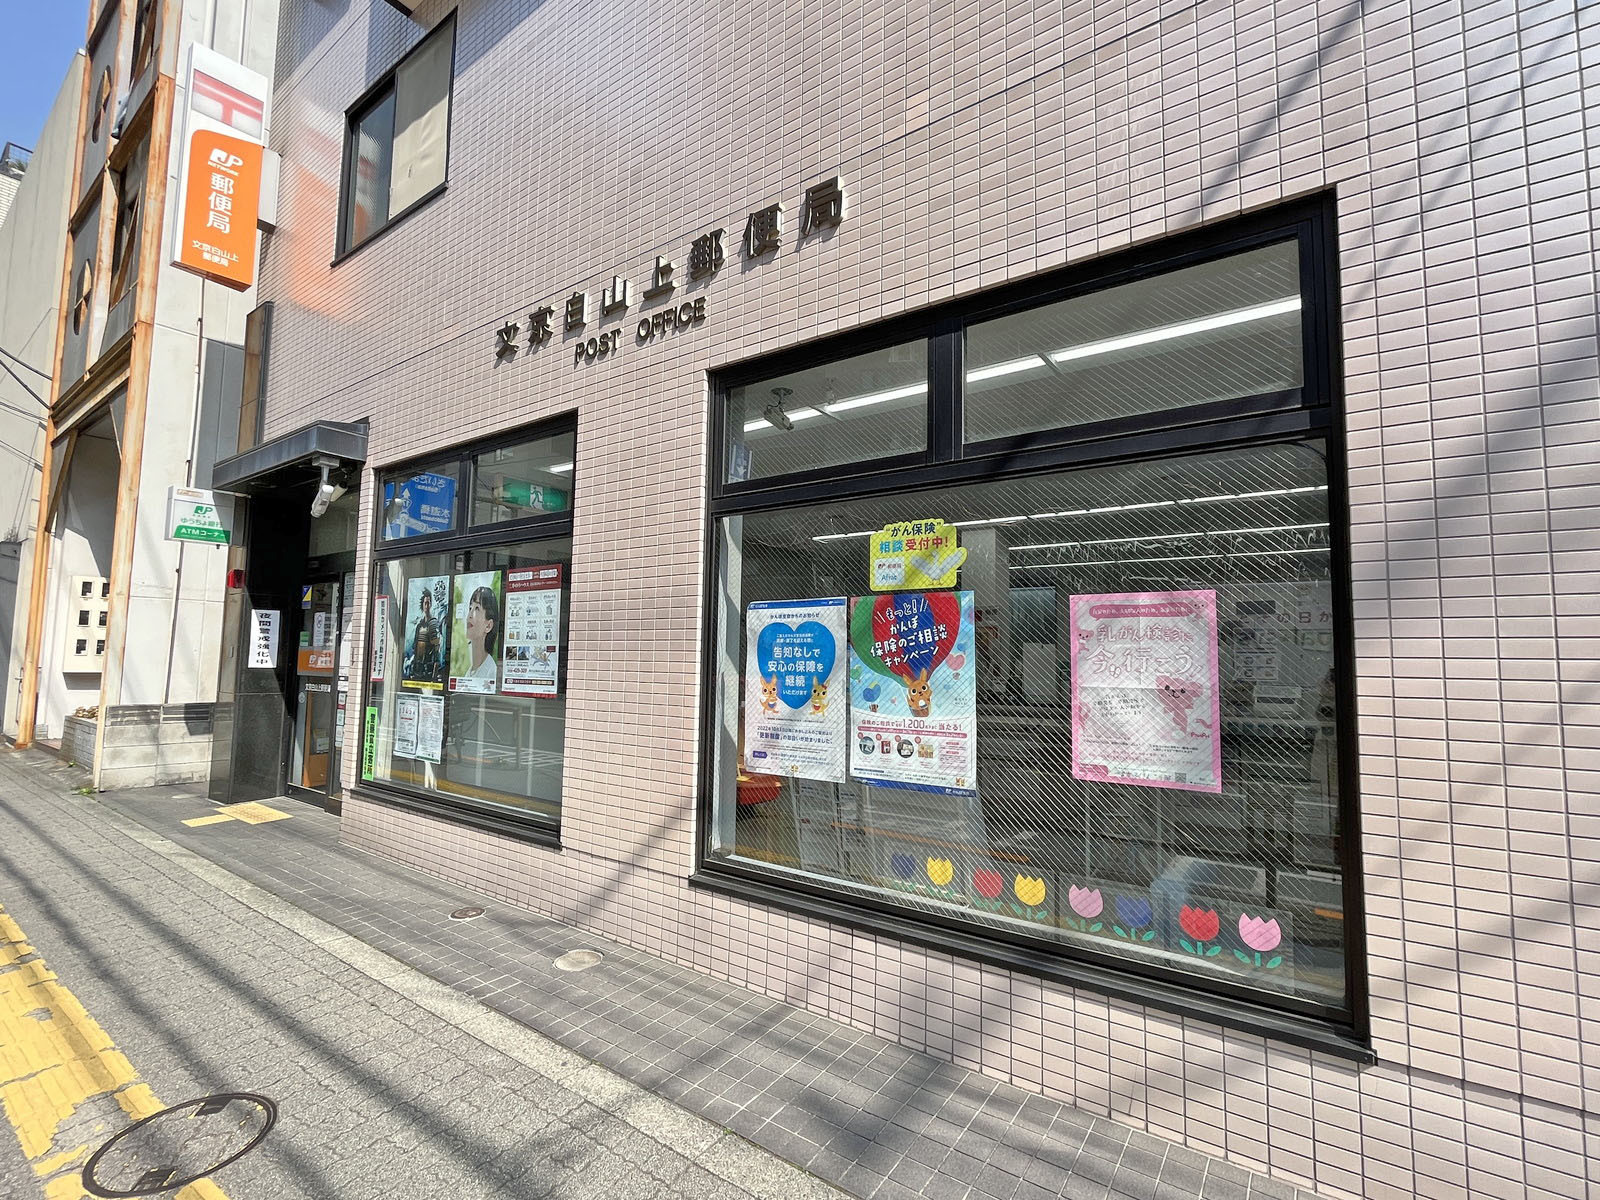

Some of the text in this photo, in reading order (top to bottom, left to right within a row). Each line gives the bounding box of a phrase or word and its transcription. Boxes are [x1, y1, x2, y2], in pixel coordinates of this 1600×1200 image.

[206, 172, 235, 234] 郵便局
[575, 296, 709, 364] POST OFFICE
[194, 505, 214, 515] JP
[180, 517, 223, 528] ゆうちょ銀行
[180, 527, 226, 538] ATMコーナー
[881, 573, 898, 581] Aflac
[1095, 623, 1194, 643] 乳がん検診に
[870, 624, 948, 657] 保険のご相談
[773, 646, 821, 658] 告知なしで
[884, 646, 939, 668] キャンペーン
[767, 660, 824, 673] 安心の保障を
[785, 675, 806, 687] 継続
